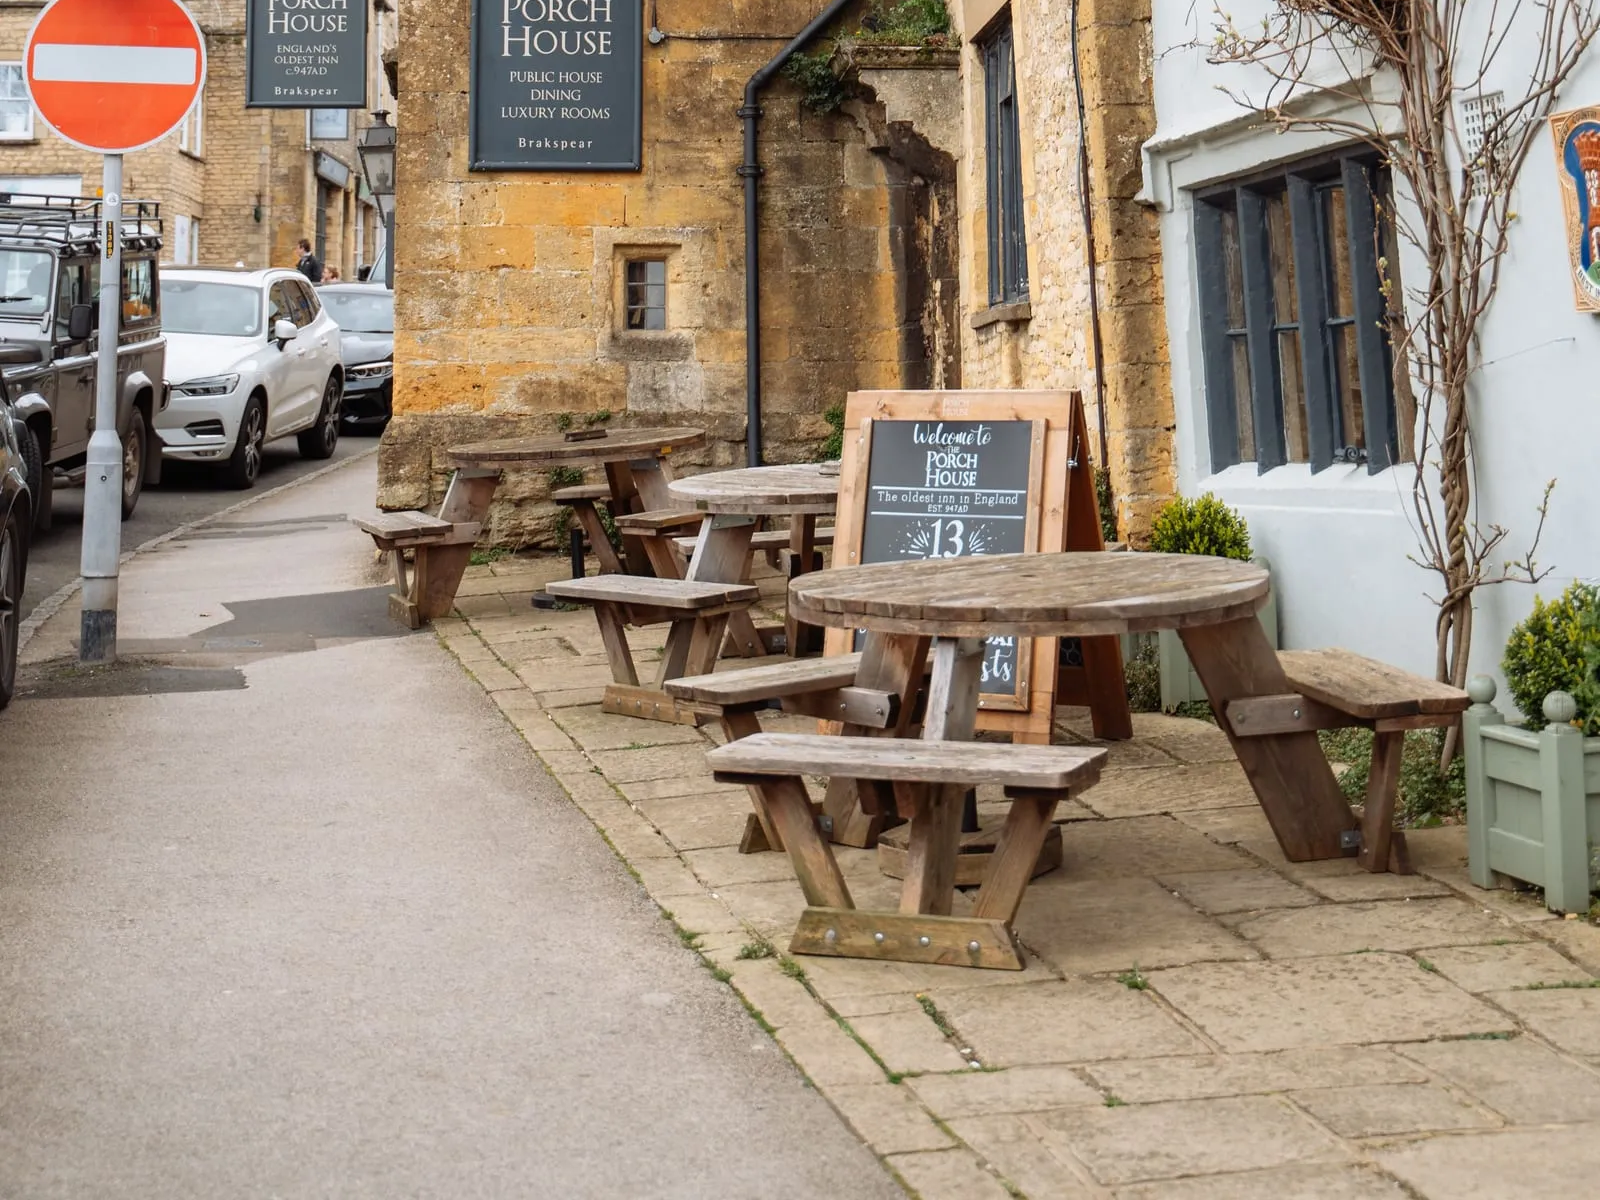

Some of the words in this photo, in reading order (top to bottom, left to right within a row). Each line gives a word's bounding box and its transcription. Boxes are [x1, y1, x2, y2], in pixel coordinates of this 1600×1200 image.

[268, 11, 348, 34] HOUSE
[501, 25, 612, 57] HOUSE
[277, 43, 337, 54] ENGLAND'S
[274, 55, 314, 65] OLDEST
[318, 56, 339, 65] INN
[509, 71, 555, 83] PUBLIC
[559, 71, 603, 83] HOUSE
[274, 86, 338, 97] Brakspear
[530, 89, 582, 101] DINING
[501, 107, 556, 119] LUXURY
[560, 107, 611, 119] ROOMS
[518, 137, 593, 151] Brakspear
[913, 422, 975, 445] Welcome
[970, 424, 992, 446] to
[926, 451, 978, 469] PORCH
[924, 469, 977, 487] HOUSE
[877, 491, 898, 502] The
[901, 491, 934, 503] oldest
[938, 493, 956, 504] inn
[960, 493, 970, 504] in
[974, 493, 1019, 507] England
[945, 505, 969, 513] 947AD
[930, 518, 964, 558] 13
